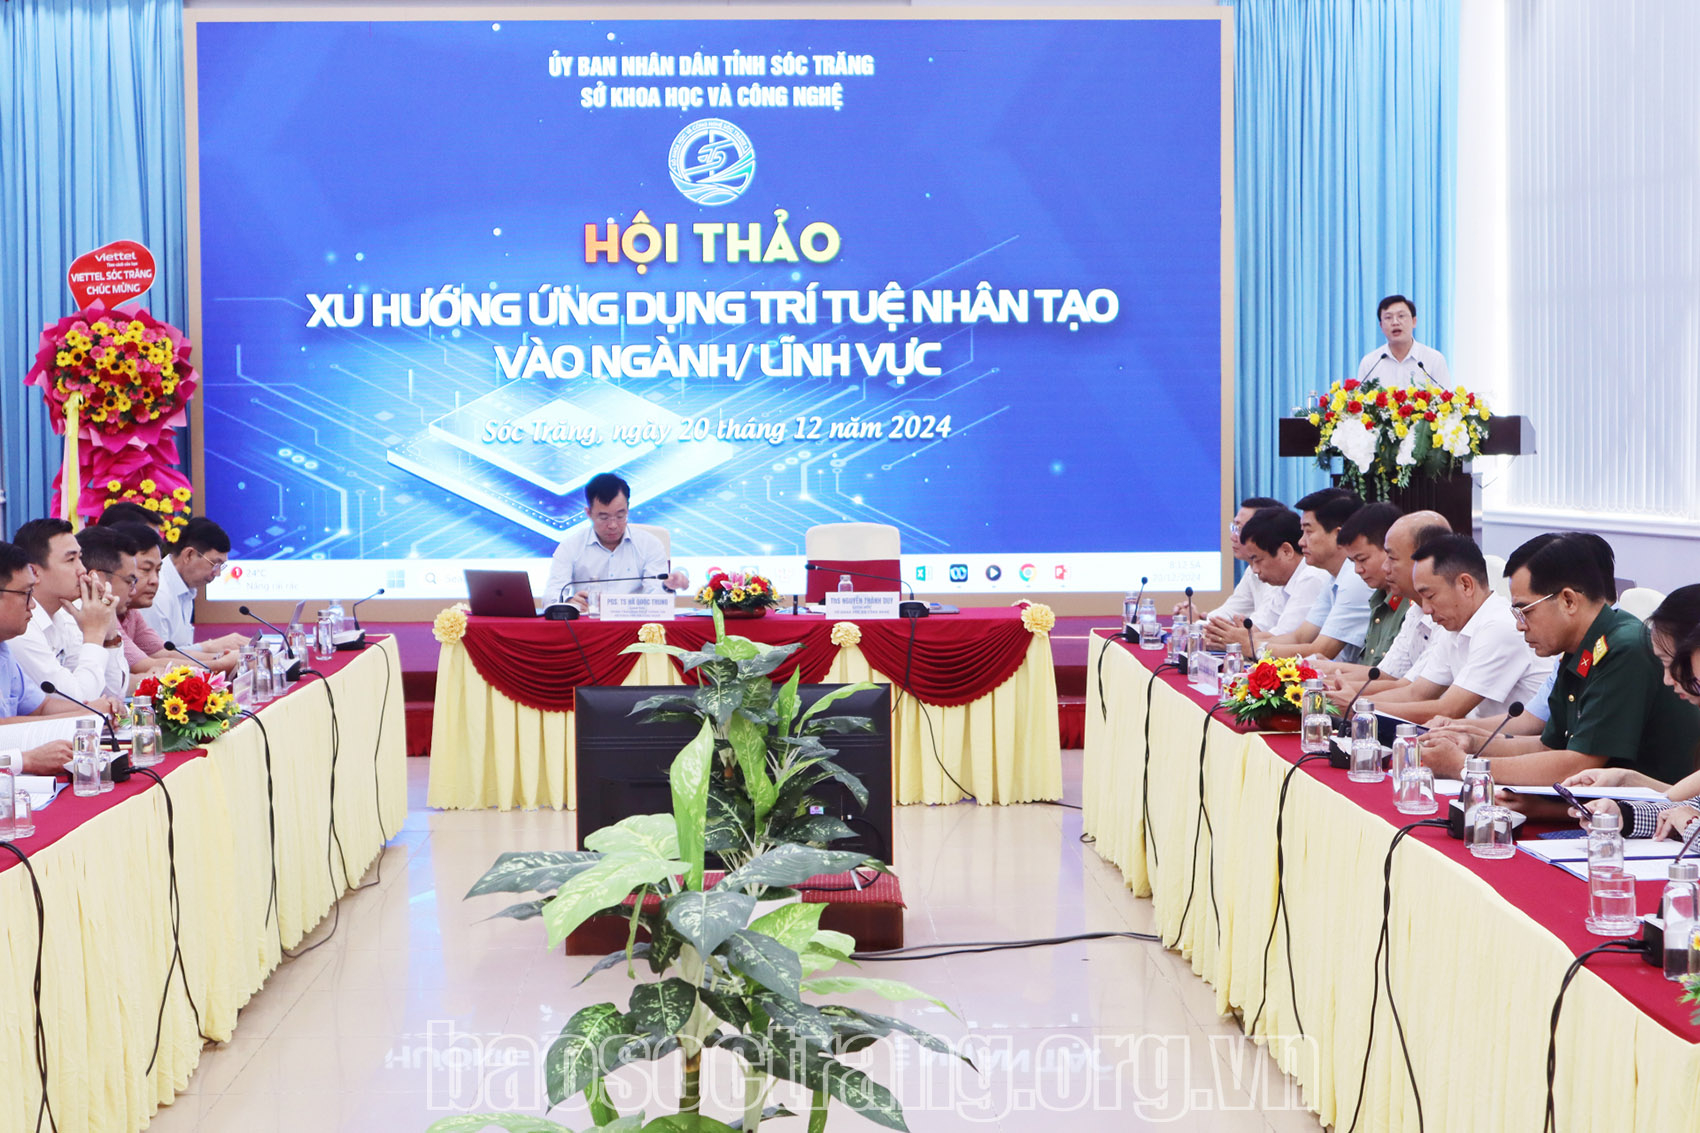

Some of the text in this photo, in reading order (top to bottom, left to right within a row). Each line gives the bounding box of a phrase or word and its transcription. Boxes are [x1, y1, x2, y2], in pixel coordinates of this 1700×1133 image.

[548, 49, 875, 76] ỦY BAN NHÂN DÂN TỈNH SÓC TRĂNG
[580, 81, 844, 111] SỞ KHOA HỌC VÀ CÔNG NGHỆ
[584, 208, 841, 276] HỘI THẢO
[70, 267, 152, 283] VIETTEL SÓC TRĂNG
[86, 282, 141, 296] CHÚC MỪNG
[306, 281, 1120, 333] XU HƯỚNG ỨNG DỤNG TRÍ TUỆ NHÂN TẠO
[493, 337, 585, 379] VÀO
[591, 337, 754, 380] NGÀNH/
[855, 337, 942, 385] VỰC
[482, 415, 952, 446] Sóc Trăng, ngày 20 tháng 12 năm 2024
